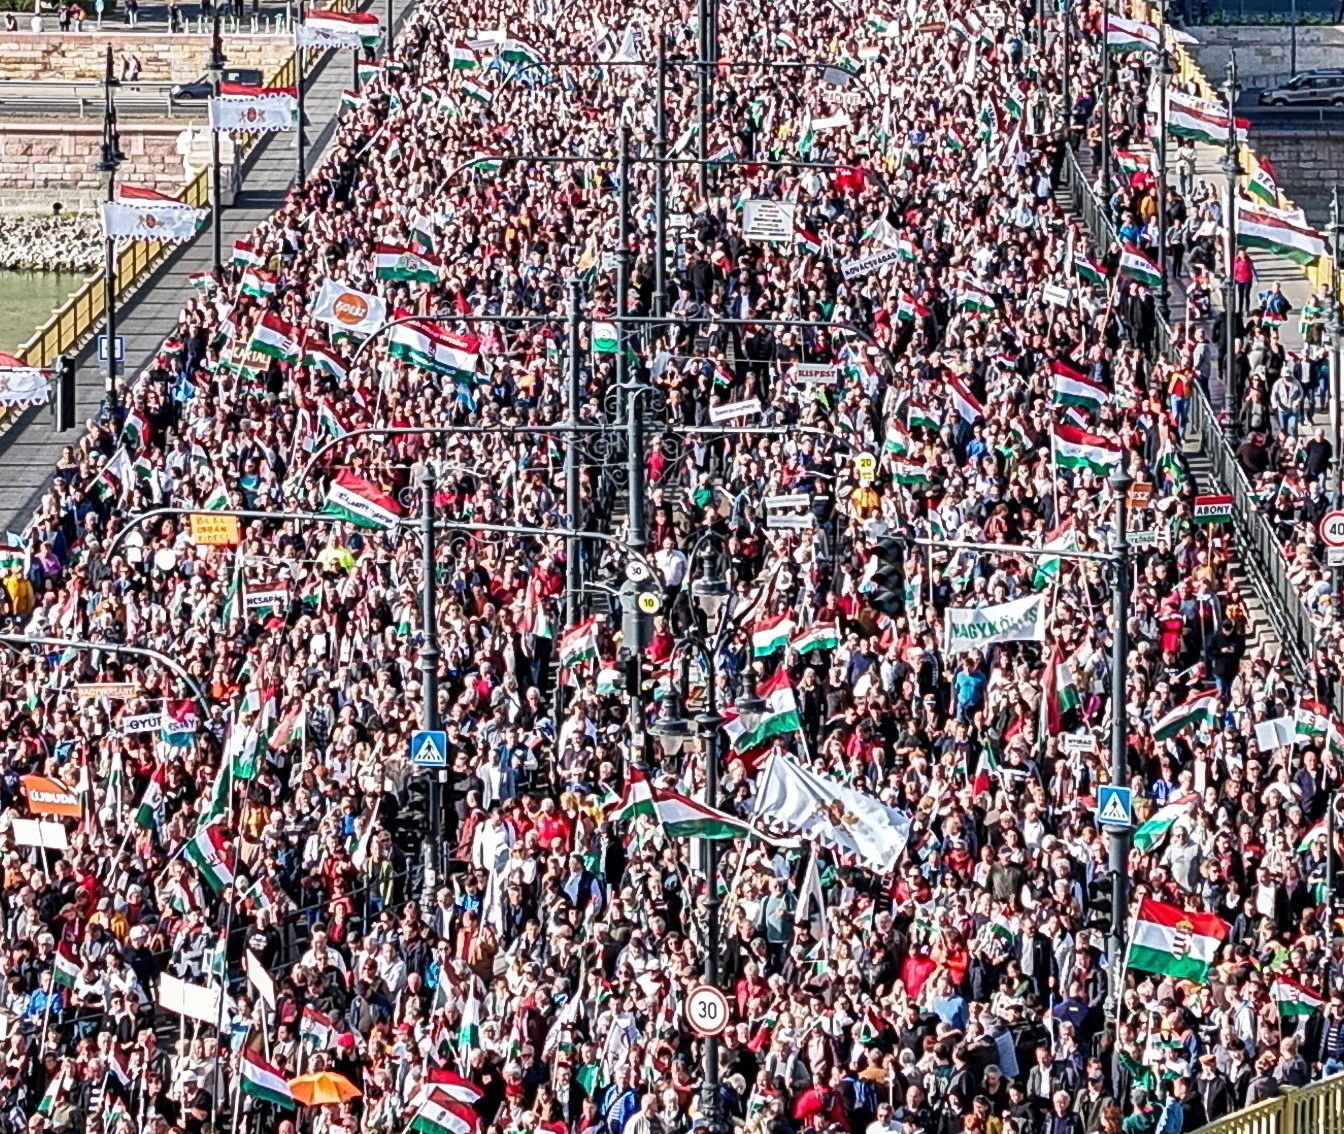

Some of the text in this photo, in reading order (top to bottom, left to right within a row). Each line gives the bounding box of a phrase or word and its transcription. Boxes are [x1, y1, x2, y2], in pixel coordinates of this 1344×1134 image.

[860, 458, 872, 467] 20
[1196, 505, 1230, 515] ABONY
[643, 598, 654, 607] 10
[698, 1000, 717, 1020] 30
